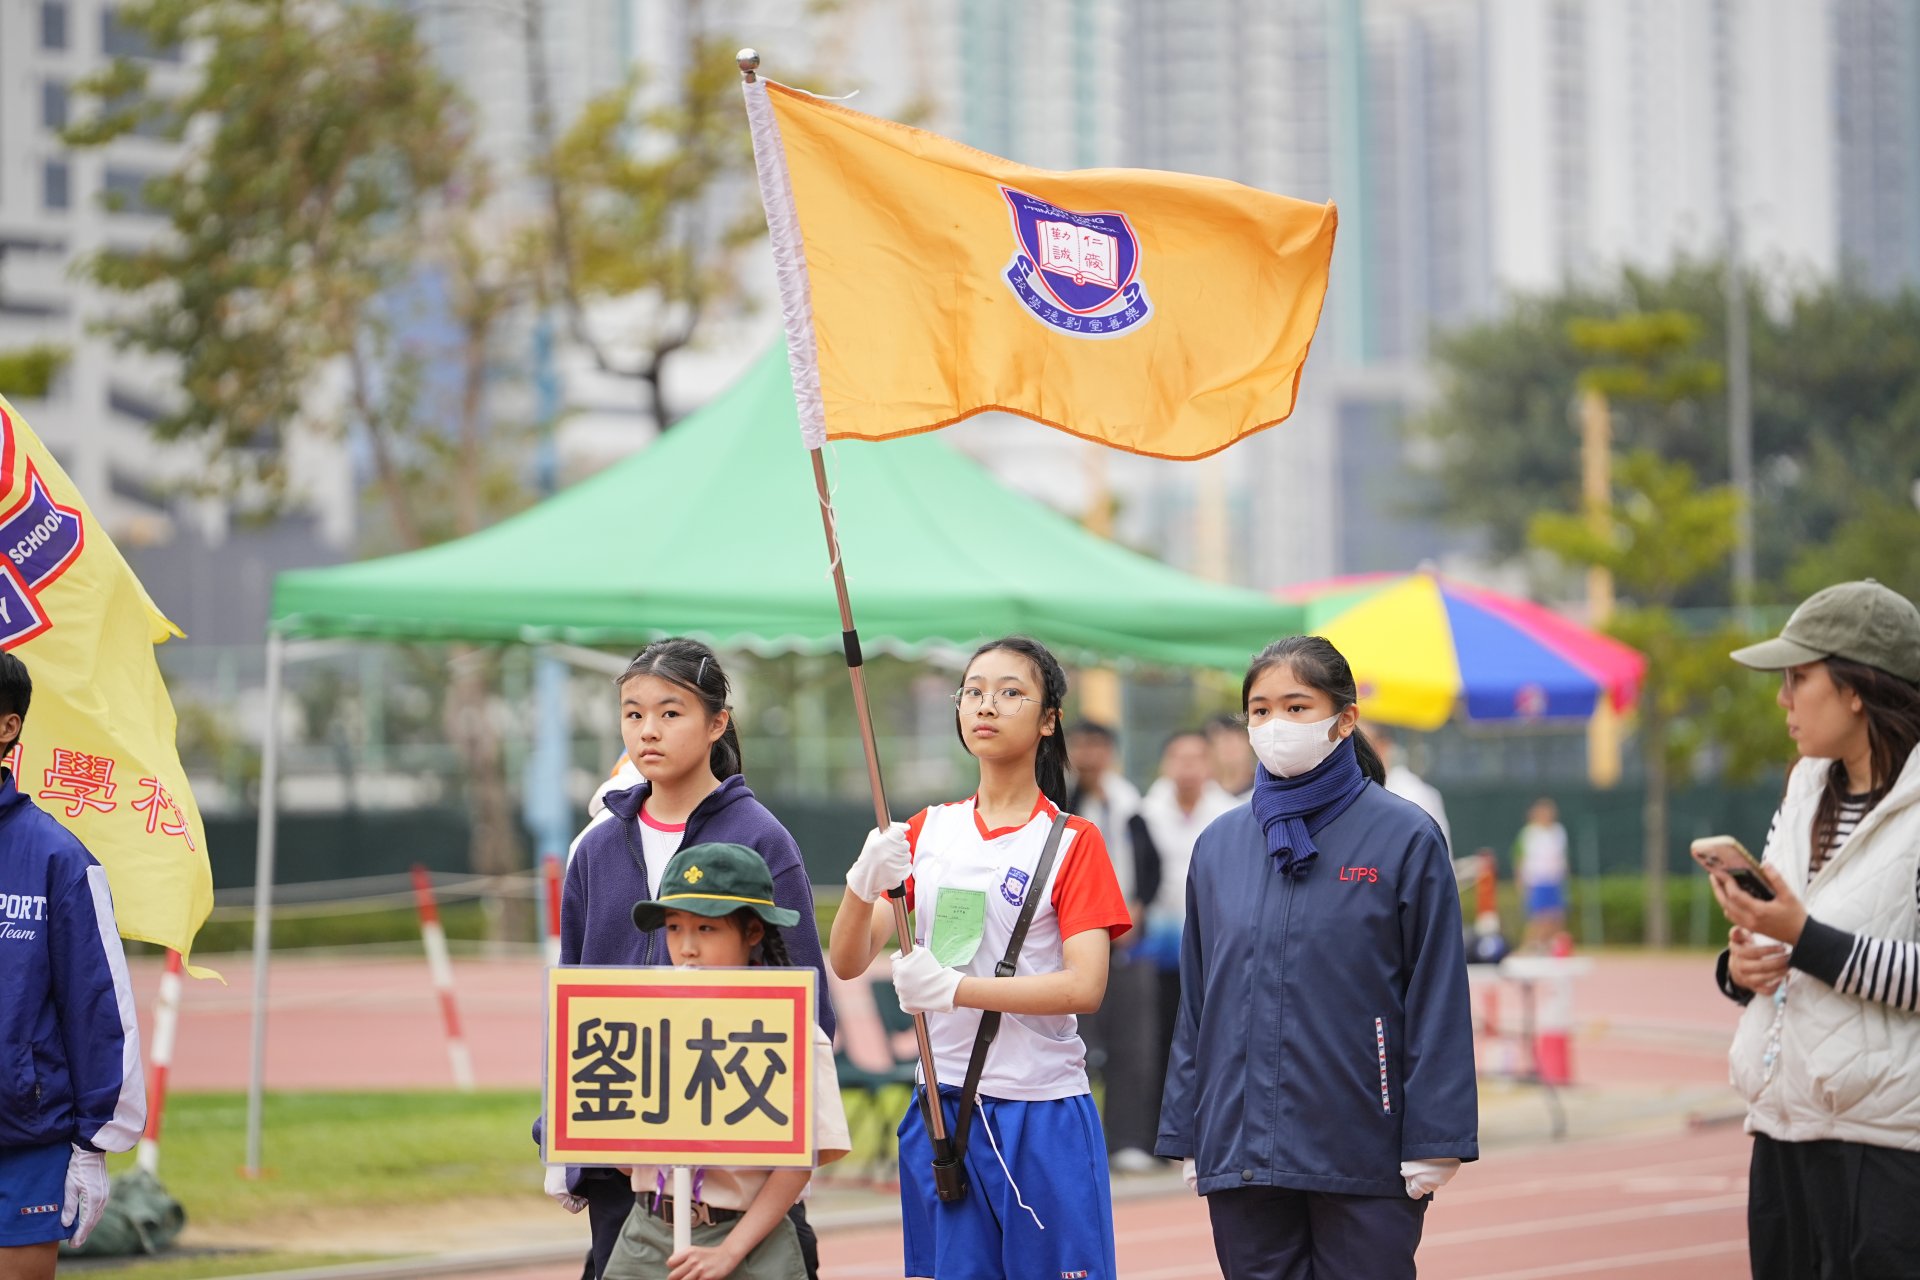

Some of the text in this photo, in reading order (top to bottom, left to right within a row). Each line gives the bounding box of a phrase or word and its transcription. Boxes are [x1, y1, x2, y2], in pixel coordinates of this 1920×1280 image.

[8, 508, 63, 565] SCHOOL
[1339, 866, 1378, 883] LTPS
[0, 893, 48, 921] PORT
[0, 921, 37, 941] Team
[572, 1017, 788, 1126] 劉校
